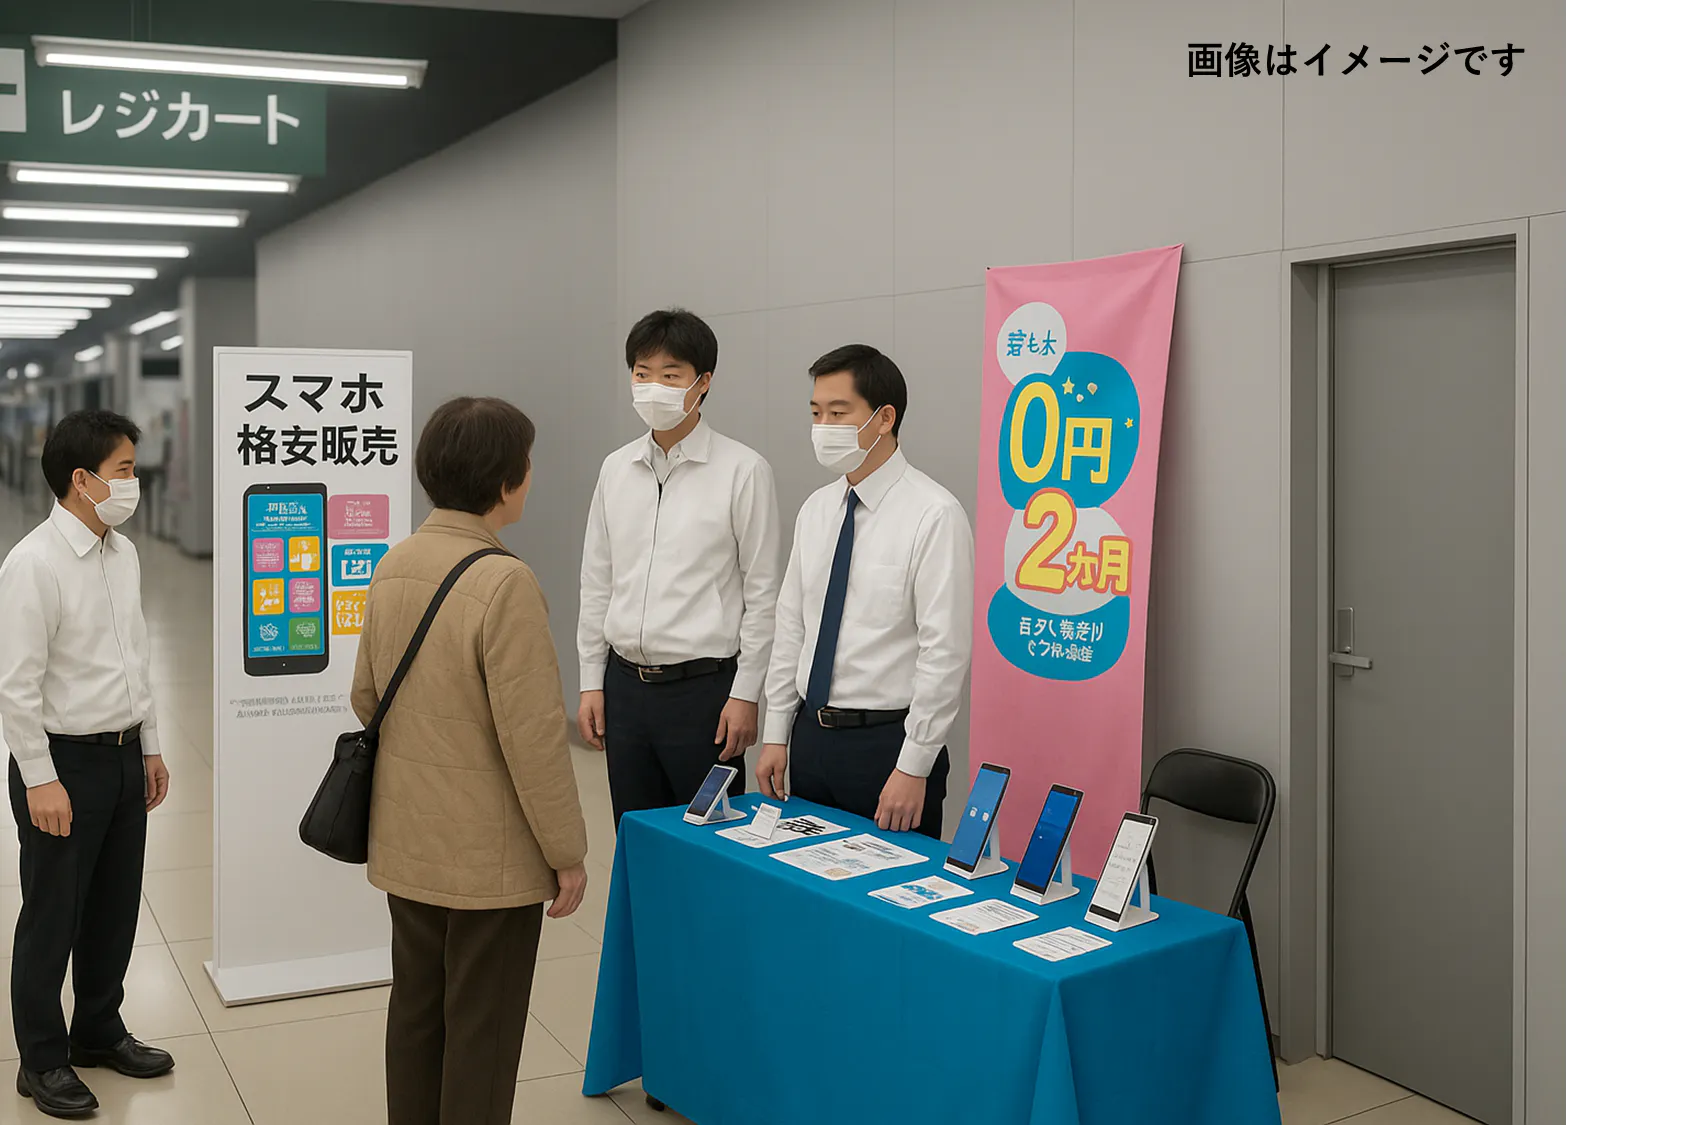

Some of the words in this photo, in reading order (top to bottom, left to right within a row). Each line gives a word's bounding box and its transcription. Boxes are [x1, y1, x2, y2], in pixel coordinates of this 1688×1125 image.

[61, 89, 300, 145] レジカート
[244, 373, 384, 413] スマホ
[237, 423, 399, 467] 格安販売
[1010, 381, 1112, 484] 0円
